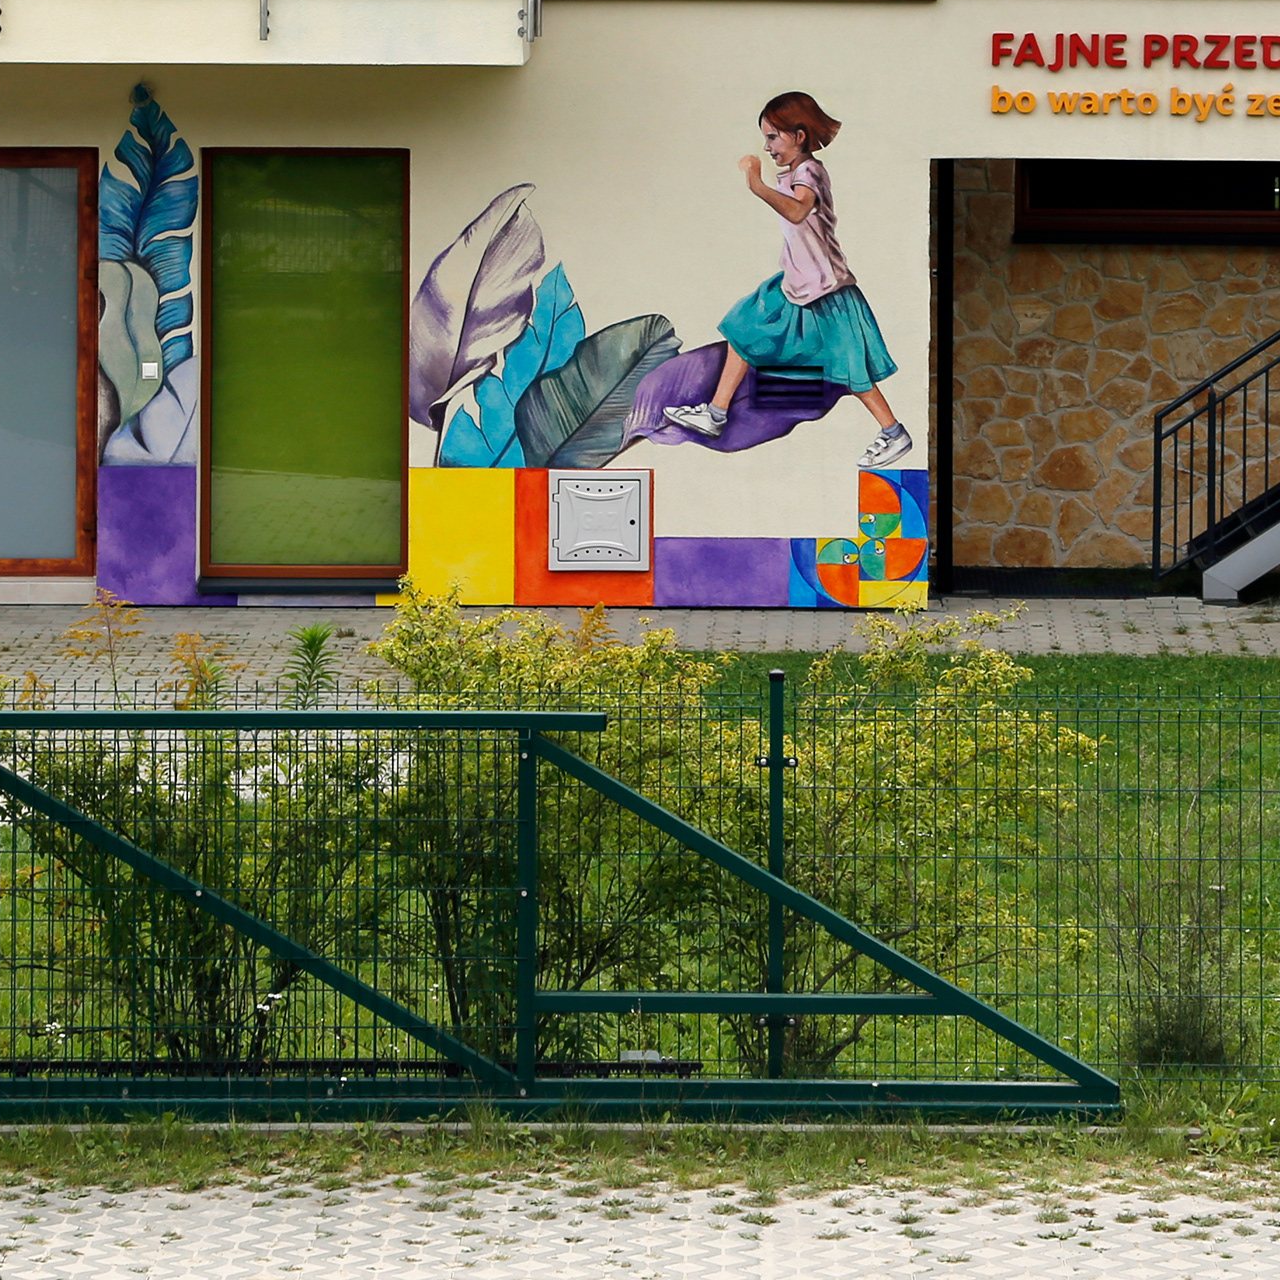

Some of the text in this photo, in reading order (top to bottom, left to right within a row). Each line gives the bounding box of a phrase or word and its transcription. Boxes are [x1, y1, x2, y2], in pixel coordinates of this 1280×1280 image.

[991, 32, 1128, 71] FAJNE
[991, 85, 1036, 114] bo
[1047, 87, 1159, 115] warto
[1170, 83, 1235, 122] być
